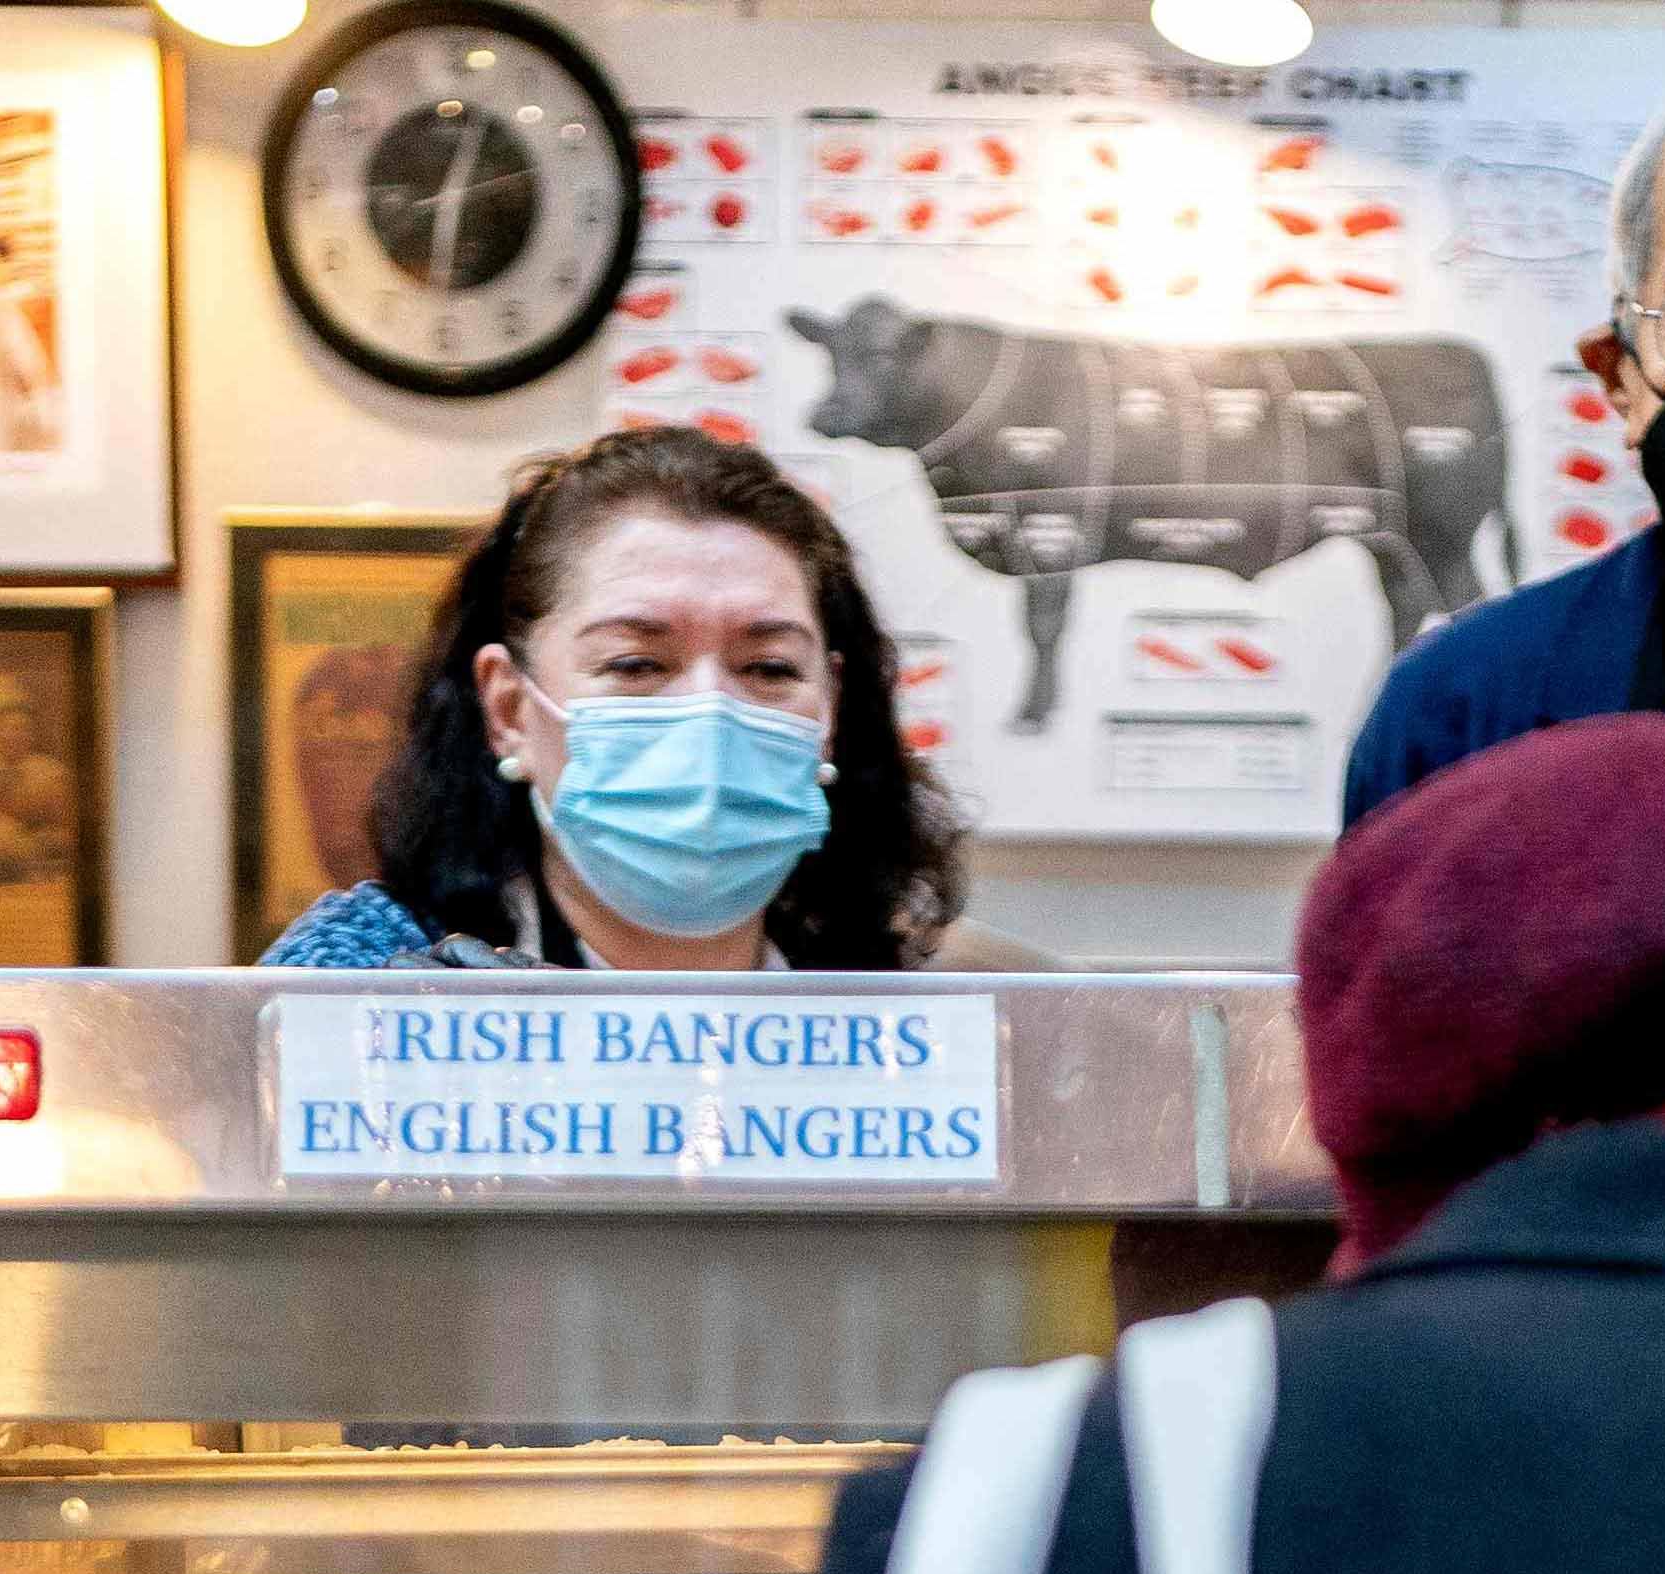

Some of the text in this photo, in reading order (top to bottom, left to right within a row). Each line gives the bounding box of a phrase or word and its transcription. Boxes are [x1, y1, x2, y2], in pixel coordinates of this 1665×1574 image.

[1287, 69, 1466, 101] CHART
[366, 1008, 932, 1068] IRISH BANGERS
[298, 1100, 613, 1155] ENGLISH
